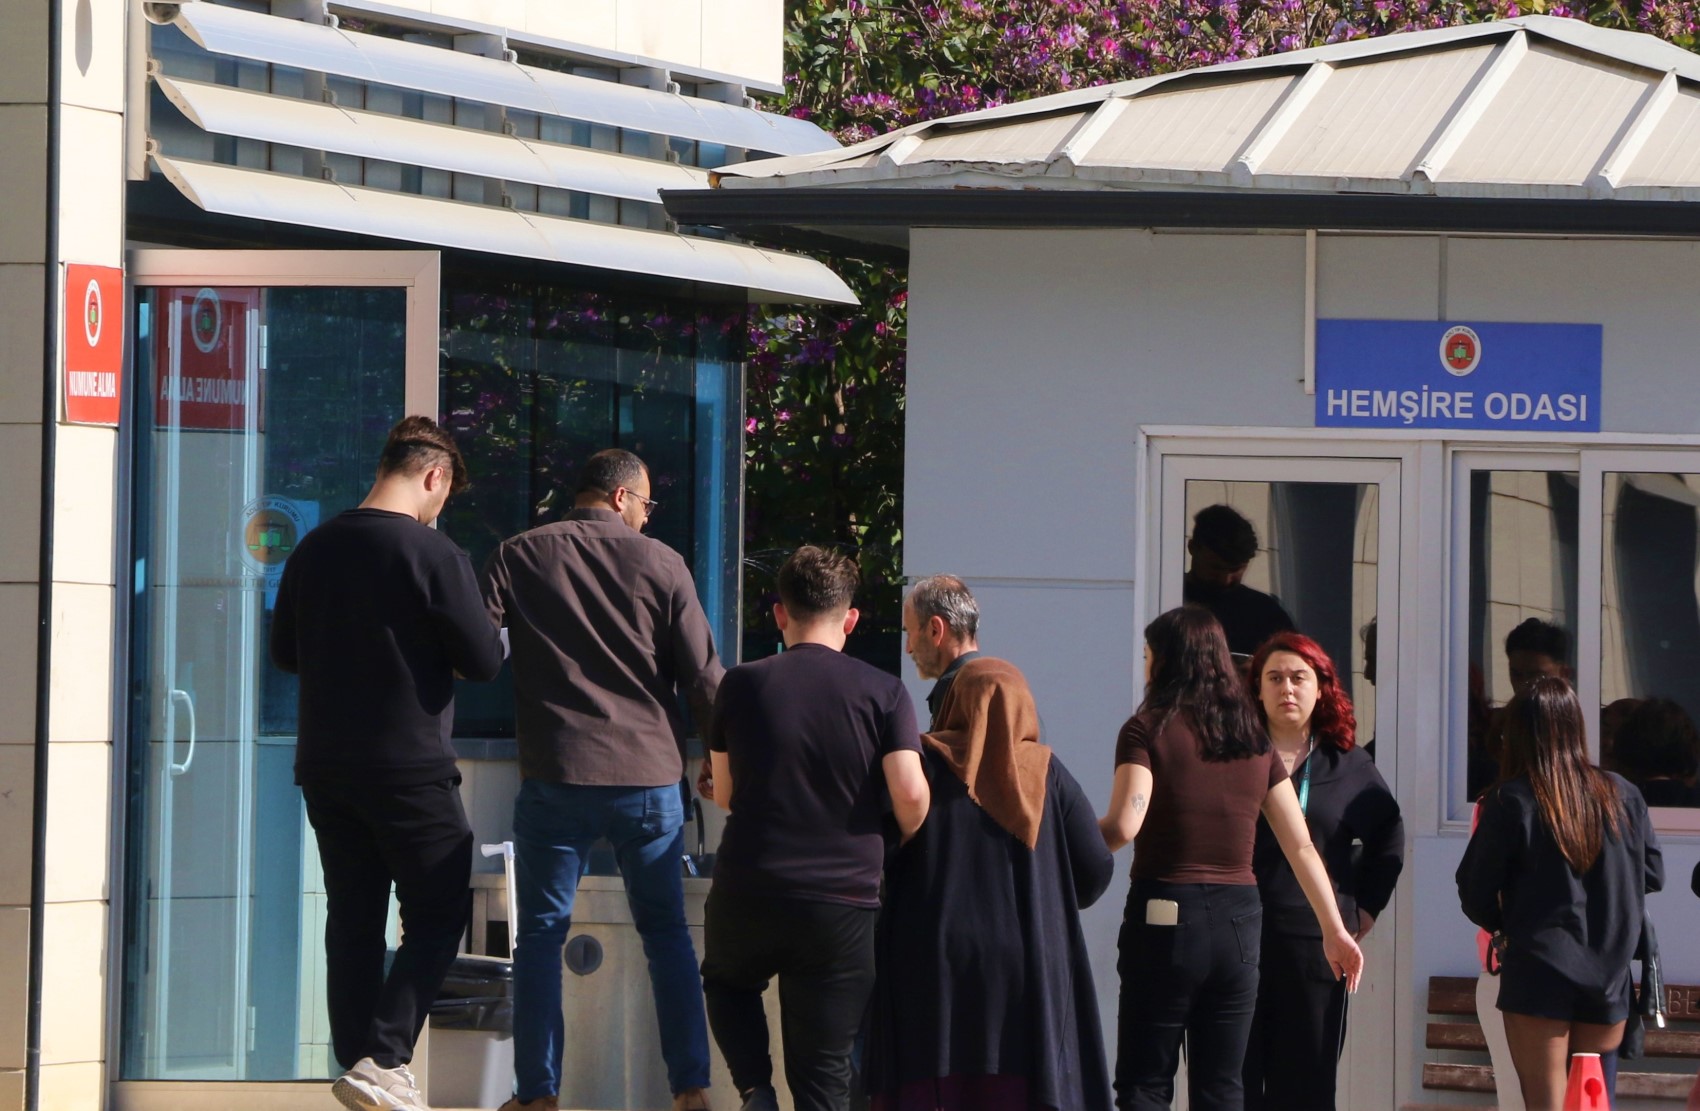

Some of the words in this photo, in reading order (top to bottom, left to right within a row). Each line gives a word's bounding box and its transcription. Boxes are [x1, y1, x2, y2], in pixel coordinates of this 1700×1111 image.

[69, 371, 98, 397] NUMUNE
[98, 371, 116, 398] ALMA
[1327, 385, 1473, 424] HEMŞİRE
[1484, 392, 1587, 421] ODASI
